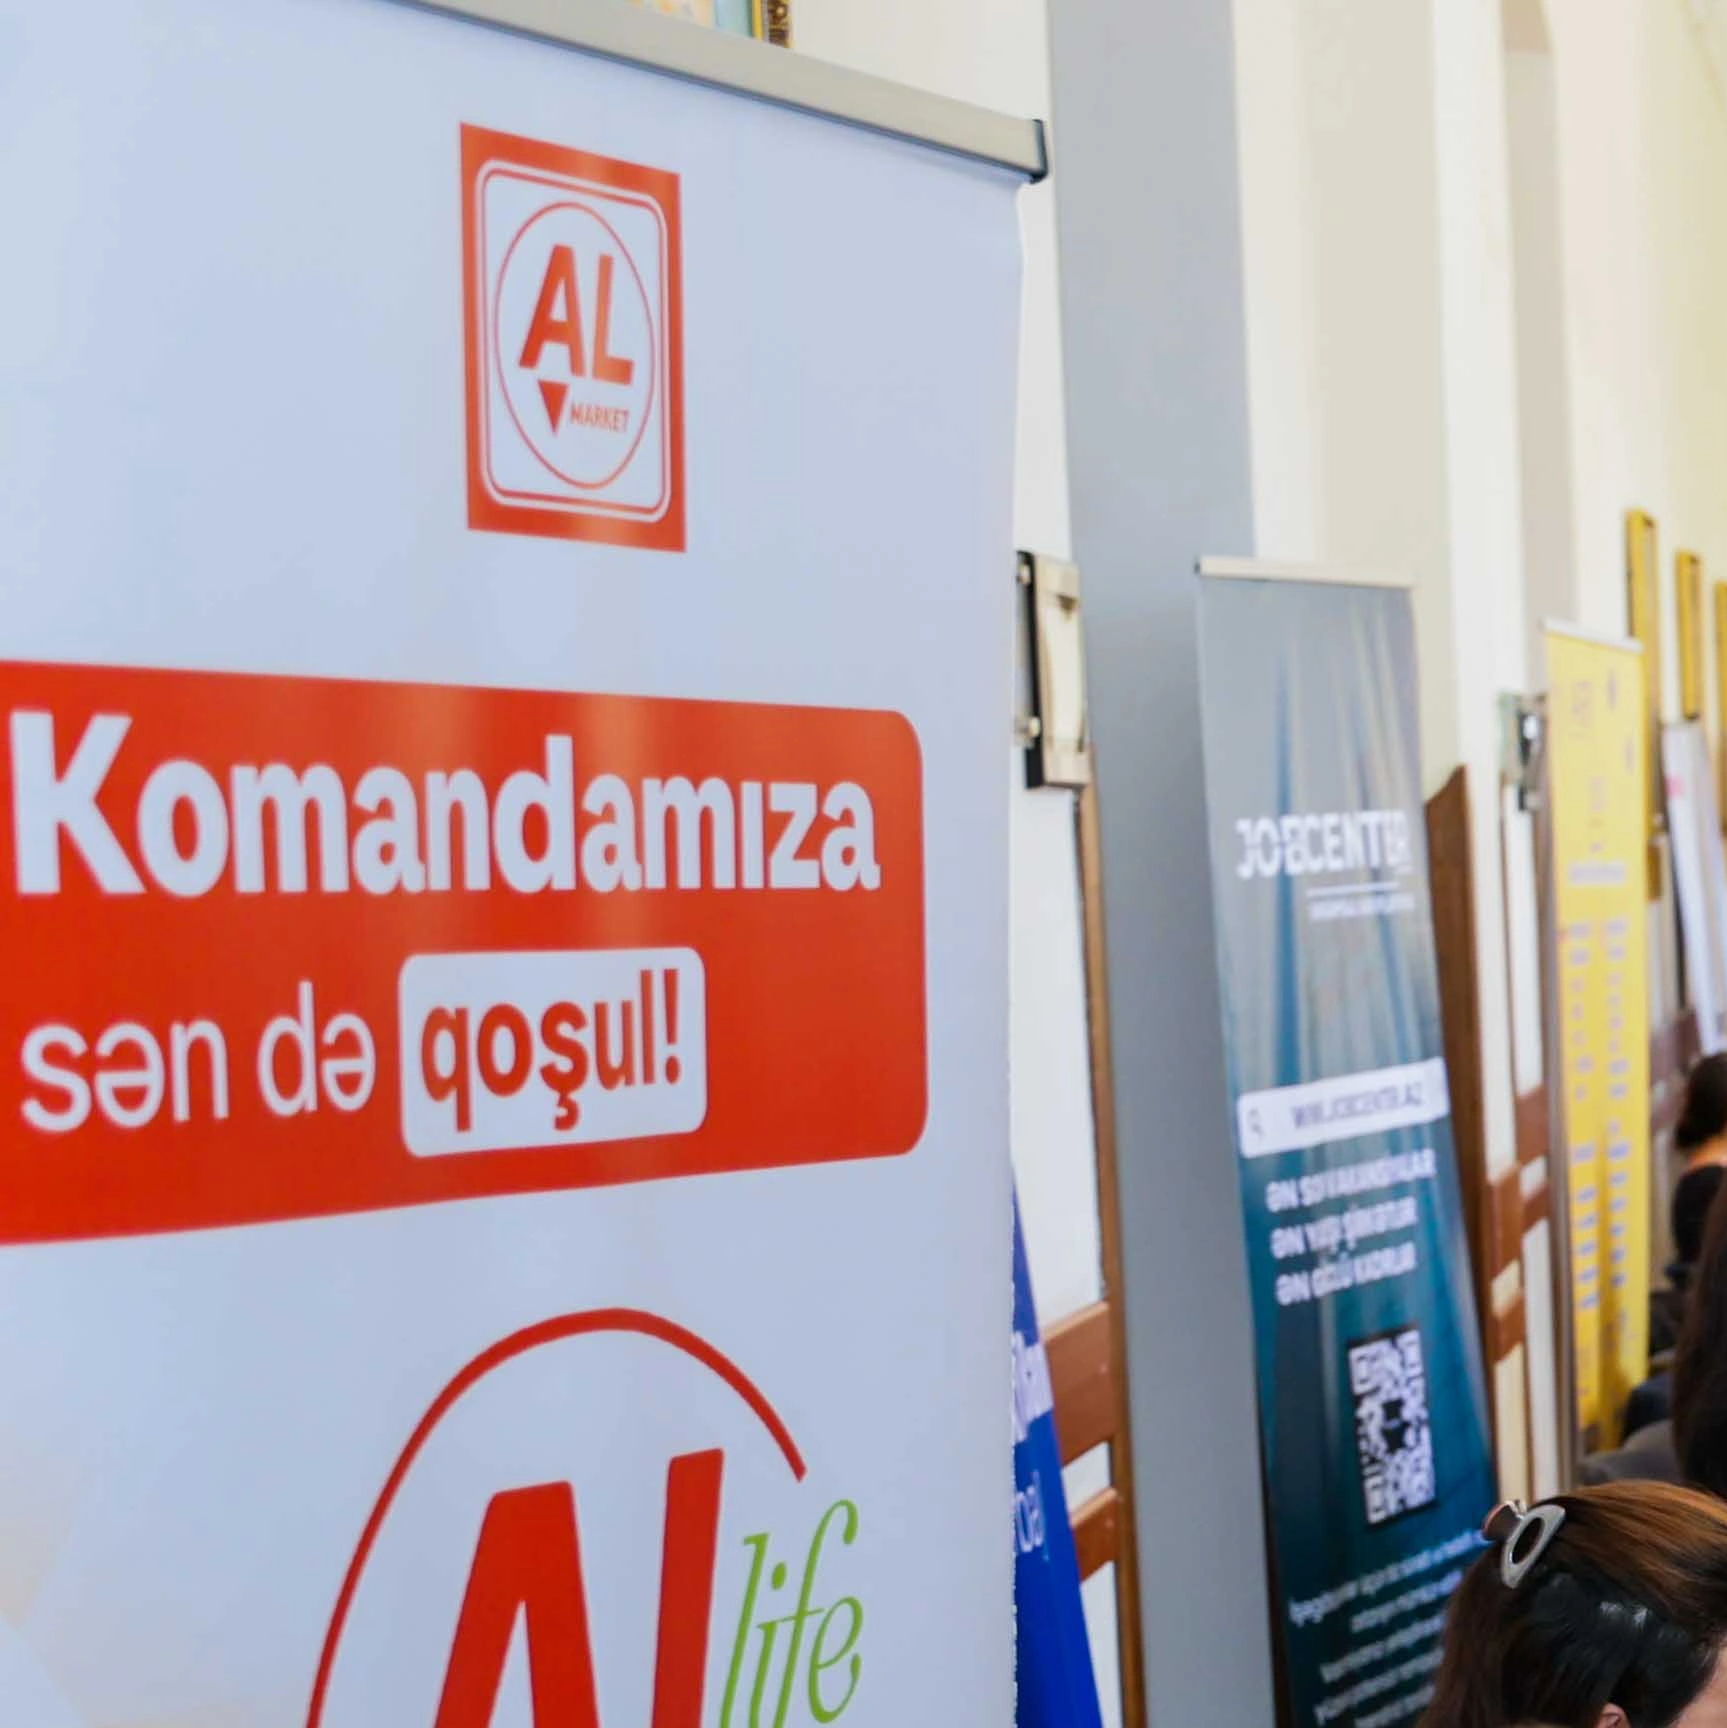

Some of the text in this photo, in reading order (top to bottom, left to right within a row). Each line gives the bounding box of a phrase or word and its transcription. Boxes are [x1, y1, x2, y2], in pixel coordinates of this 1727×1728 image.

[518, 243, 635, 386] AL
[569, 401, 630, 434] MARKET
[8, 709, 881, 898] Komandamıza
[20, 968, 681, 1133] sən də qoşul!
